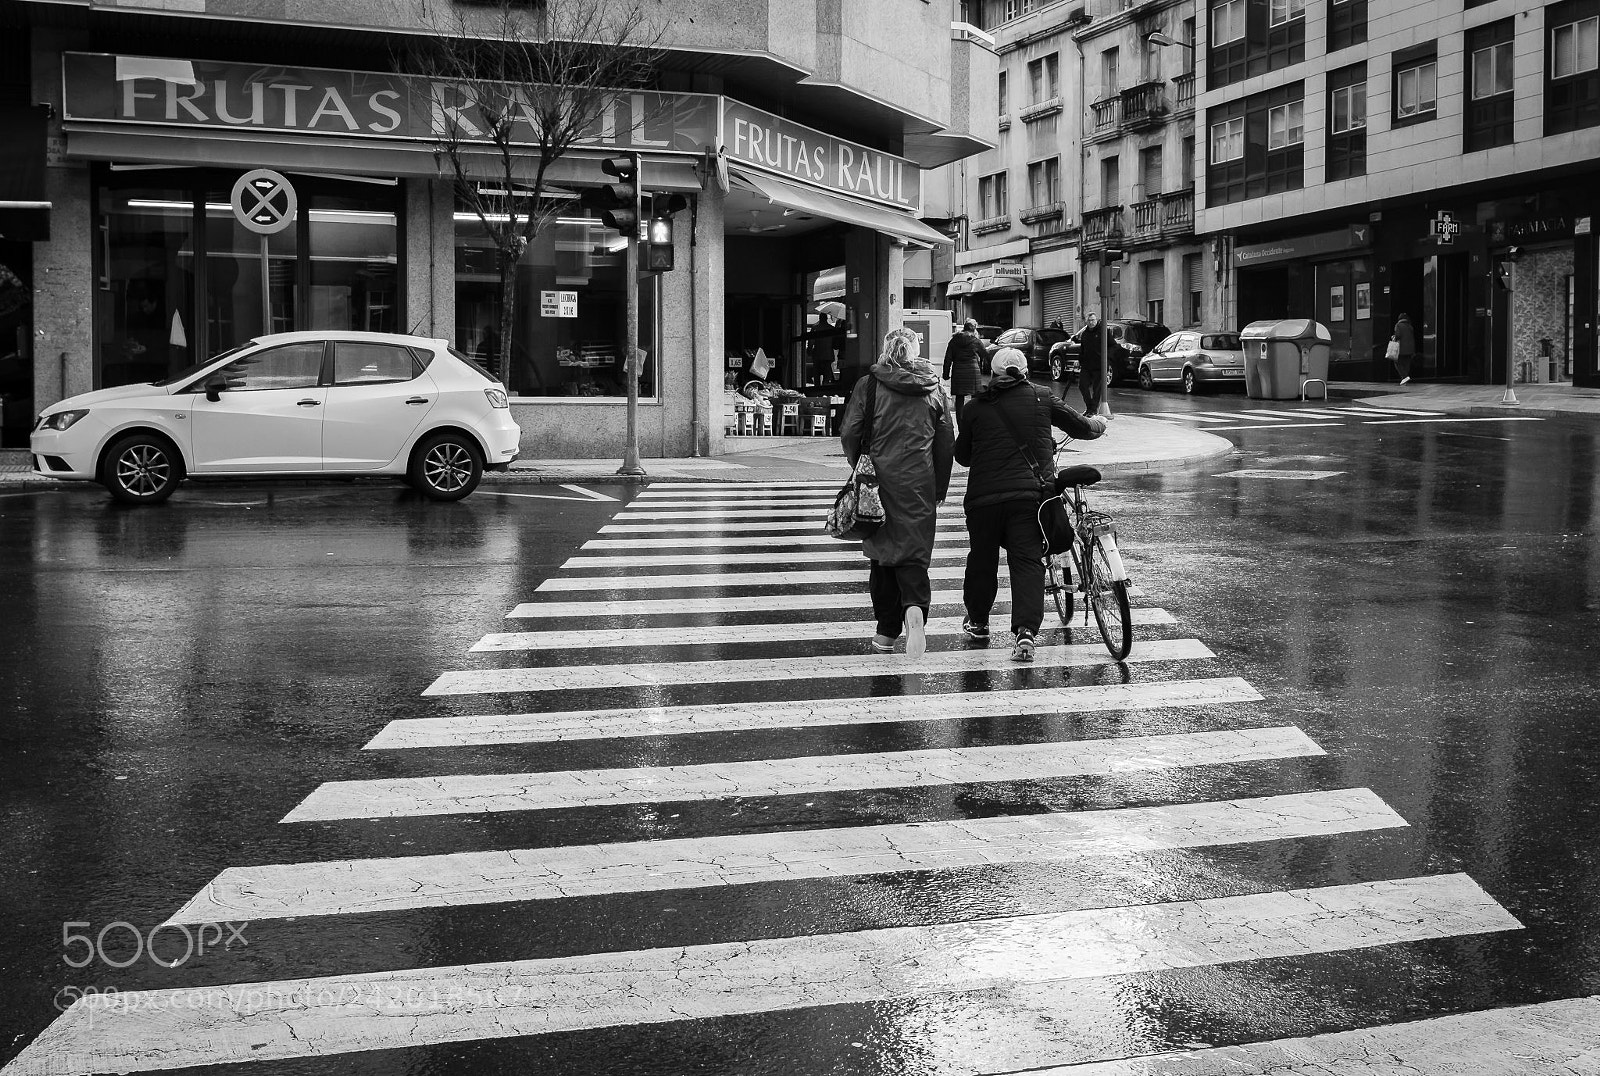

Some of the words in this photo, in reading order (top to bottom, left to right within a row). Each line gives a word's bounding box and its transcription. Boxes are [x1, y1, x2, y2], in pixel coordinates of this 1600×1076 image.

[122, 77, 402, 134] FRUTAS
[430, 82, 671, 147] RAUL
[734, 117, 825, 181] FRUTAS
[837, 143, 910, 204] RAUL
[1437, 222, 1458, 233] FARM
[995, 267, 1022, 275] olivetti
